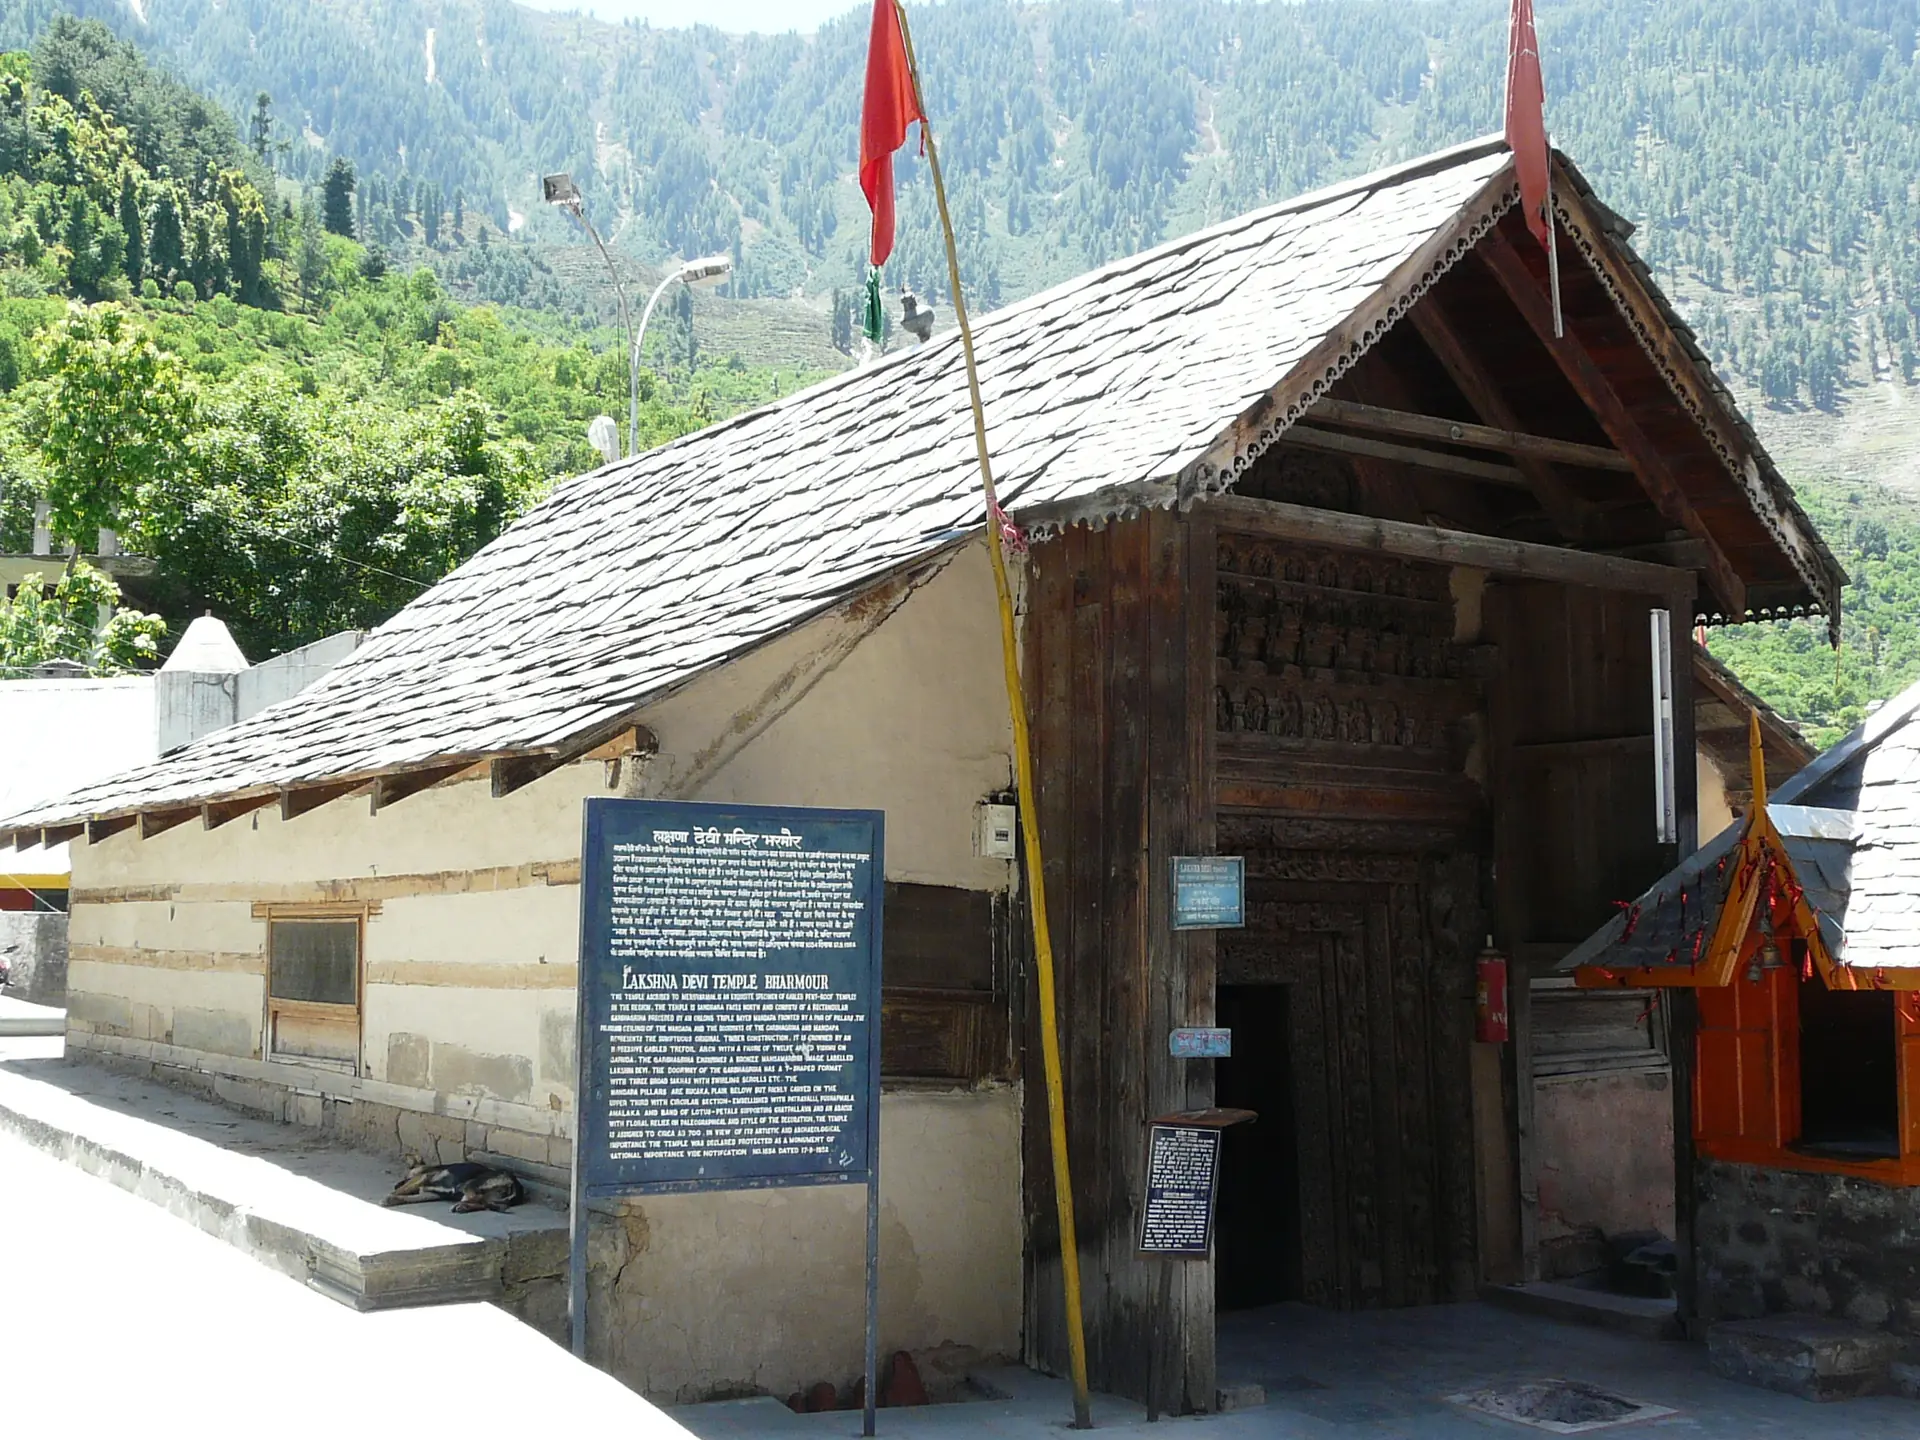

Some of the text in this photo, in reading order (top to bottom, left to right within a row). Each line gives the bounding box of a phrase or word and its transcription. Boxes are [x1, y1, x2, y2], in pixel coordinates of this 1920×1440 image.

[653, 826, 802, 849] लक्षणा देवी मन्दिर भरमौर
[623, 974, 828, 989] LAKSHNA DEVI TEMPLE BHARMOUR
[718, 1045, 735, 1053] WITH
[652, 1067, 664, 1075] THE
[710, 1066, 721, 1074] THE
[610, 1078, 626, 1086] WITH
[640, 1088, 666, 1096] PILLARS
[671, 1088, 683, 1096] ARE
[730, 1086, 752, 1094] BELOW
[824, 1085, 836, 1093] THE
[771, 1096, 785, 1104] WITH
[688, 1129, 701, 1137] 700
[649, 1141, 660, 1149] THE
[664, 1139, 688, 1148] TEMPLE
[738, 1137, 772, 1146] PROTECTED
[644, 1150, 684, 1158] IMPORTANCE
